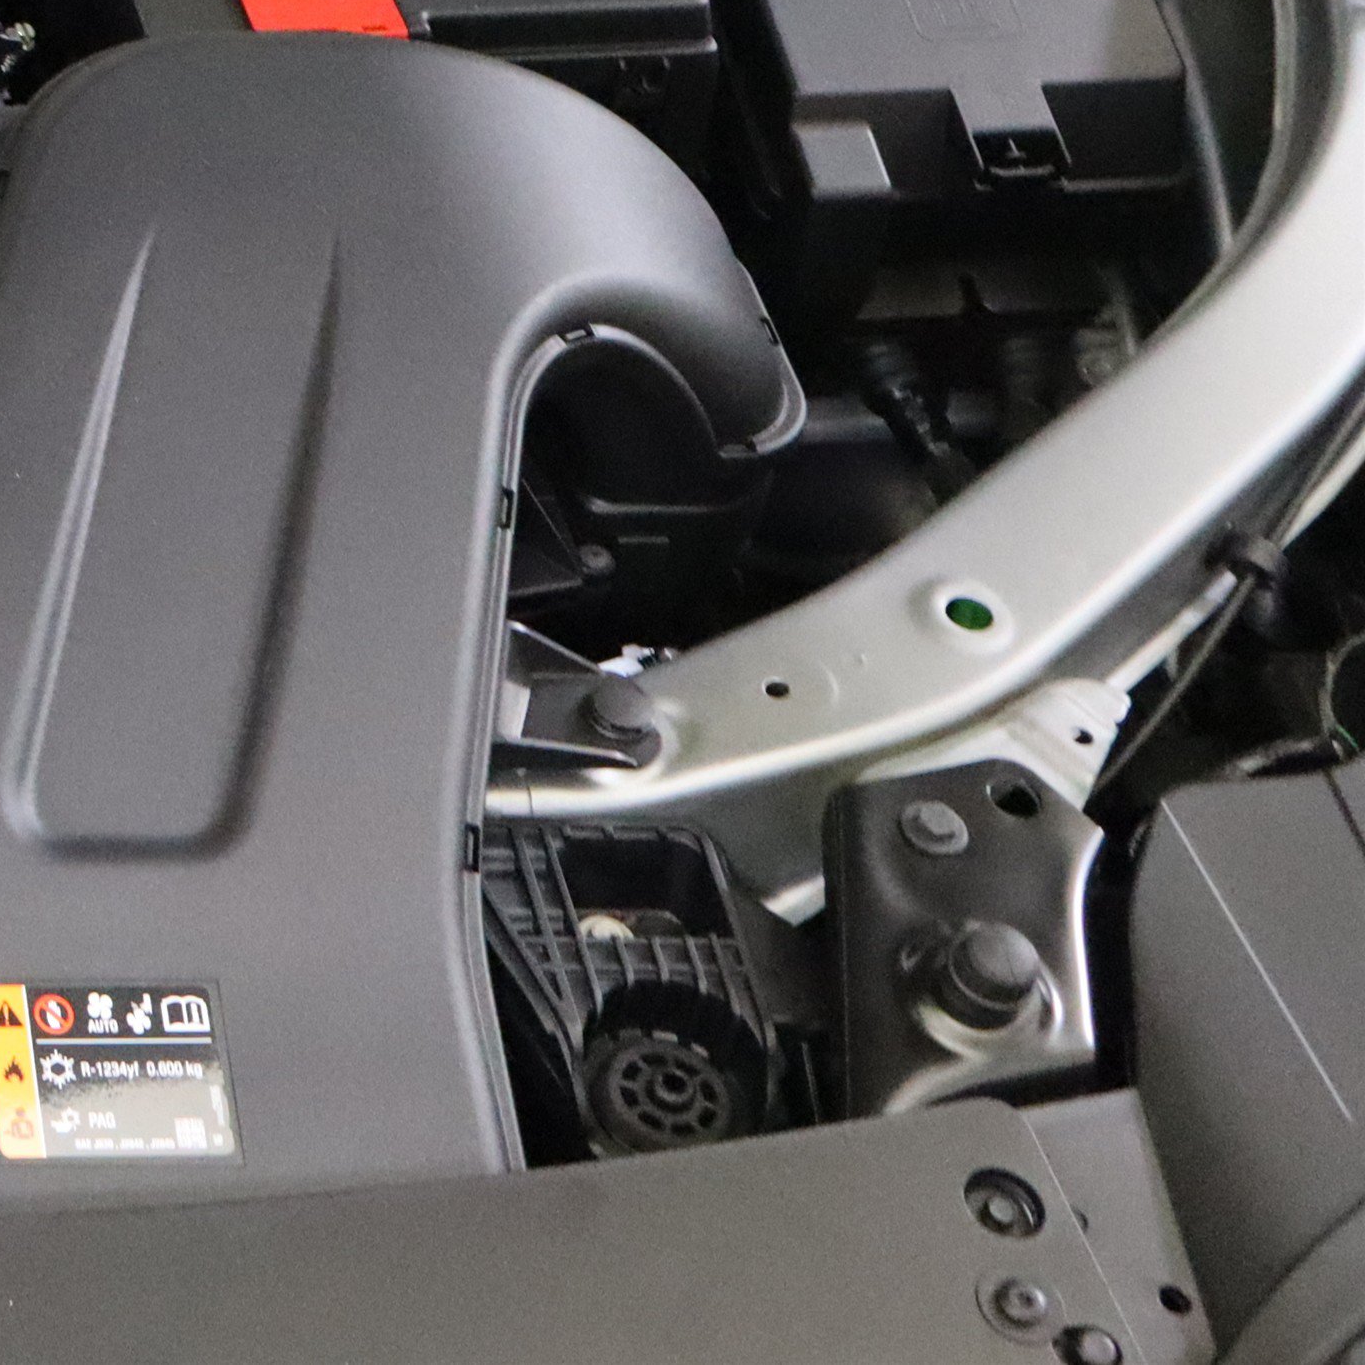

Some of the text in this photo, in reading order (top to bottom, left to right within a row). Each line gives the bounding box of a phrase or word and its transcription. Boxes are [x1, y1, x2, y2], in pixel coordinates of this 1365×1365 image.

[88, 1019, 119, 1034] AUTO
[186, 1060, 204, 1080] kg
[88, 1111, 117, 1129] PAG
